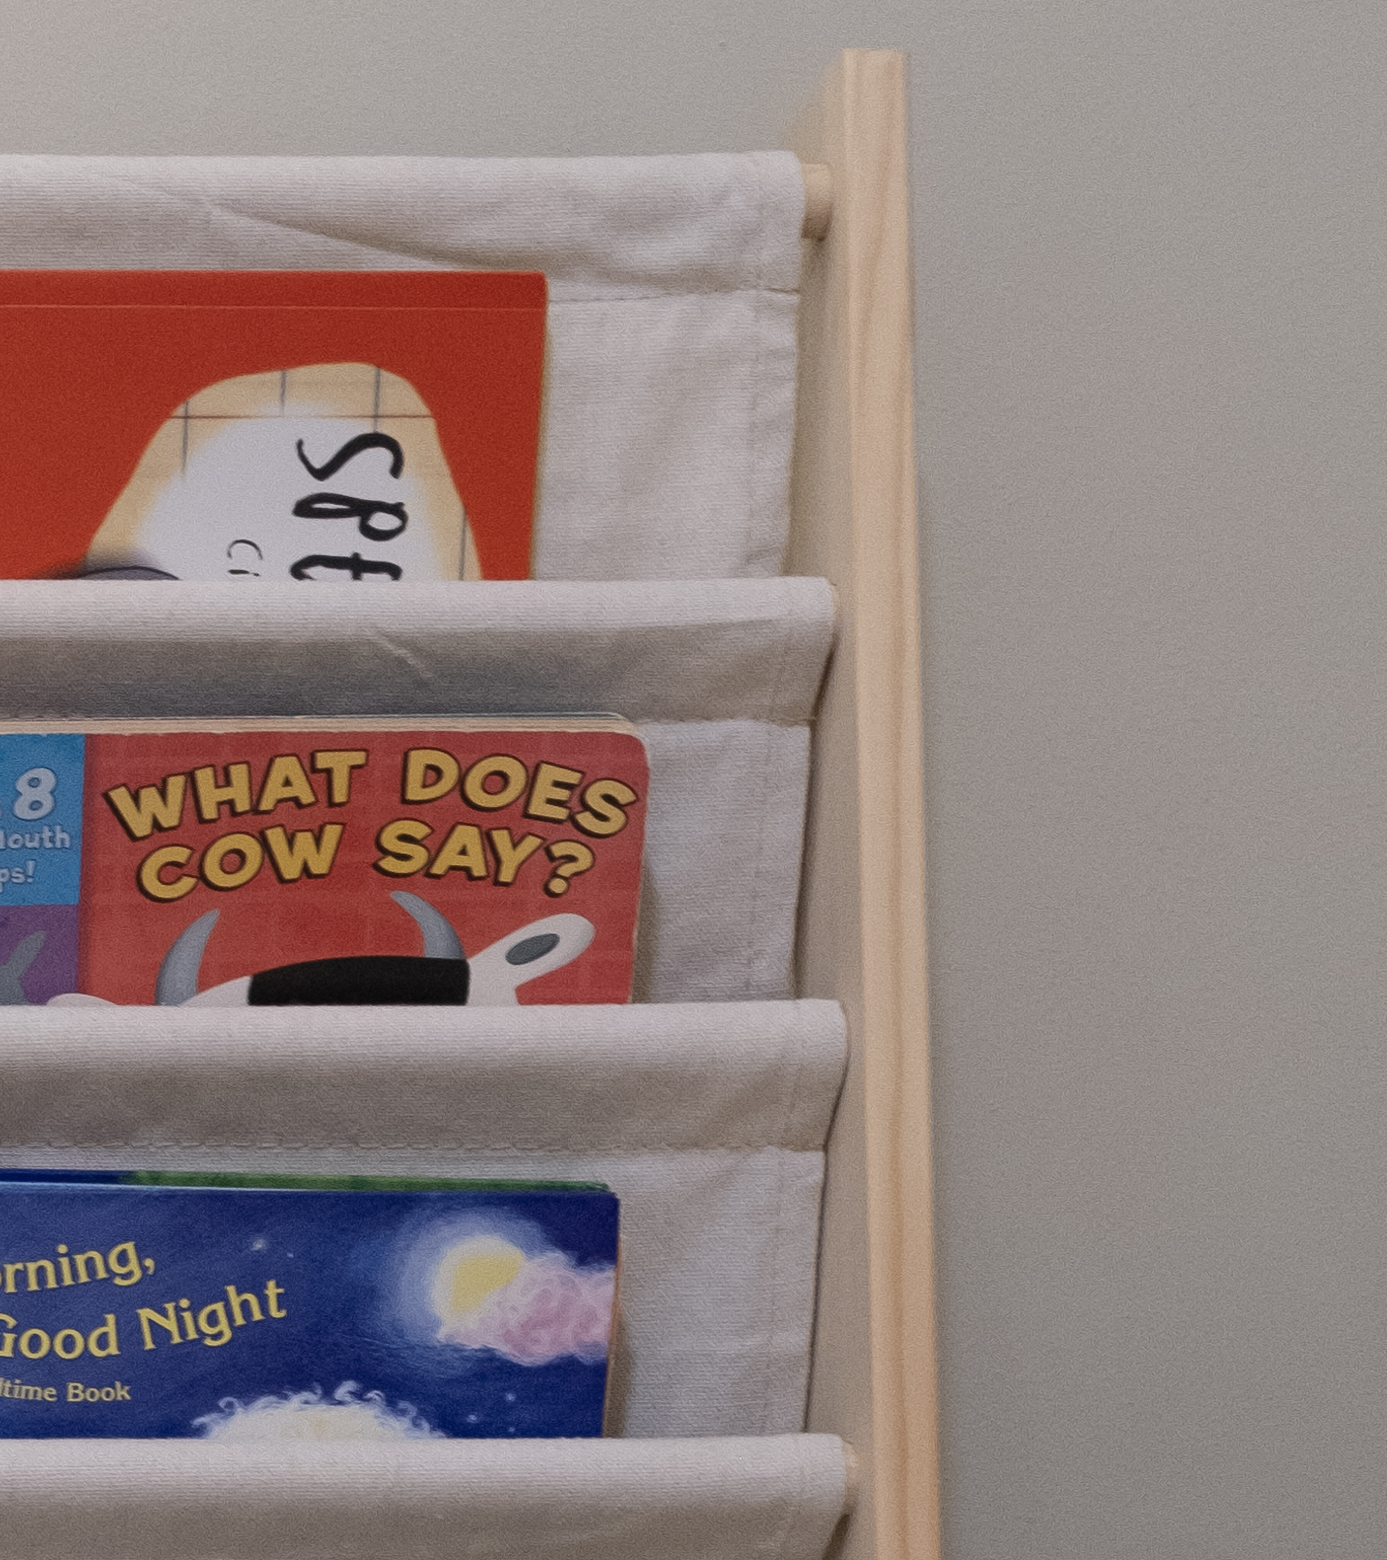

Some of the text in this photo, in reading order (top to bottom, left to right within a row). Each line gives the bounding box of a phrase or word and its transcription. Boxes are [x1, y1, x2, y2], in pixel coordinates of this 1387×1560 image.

[13, 768, 56, 821] 8
[108, 748, 638, 840] WHAT DOES
[137, 820, 595, 902] COW SAY?
[136, 1278, 288, 1353] Night
[67, 1380, 132, 1403] Book
